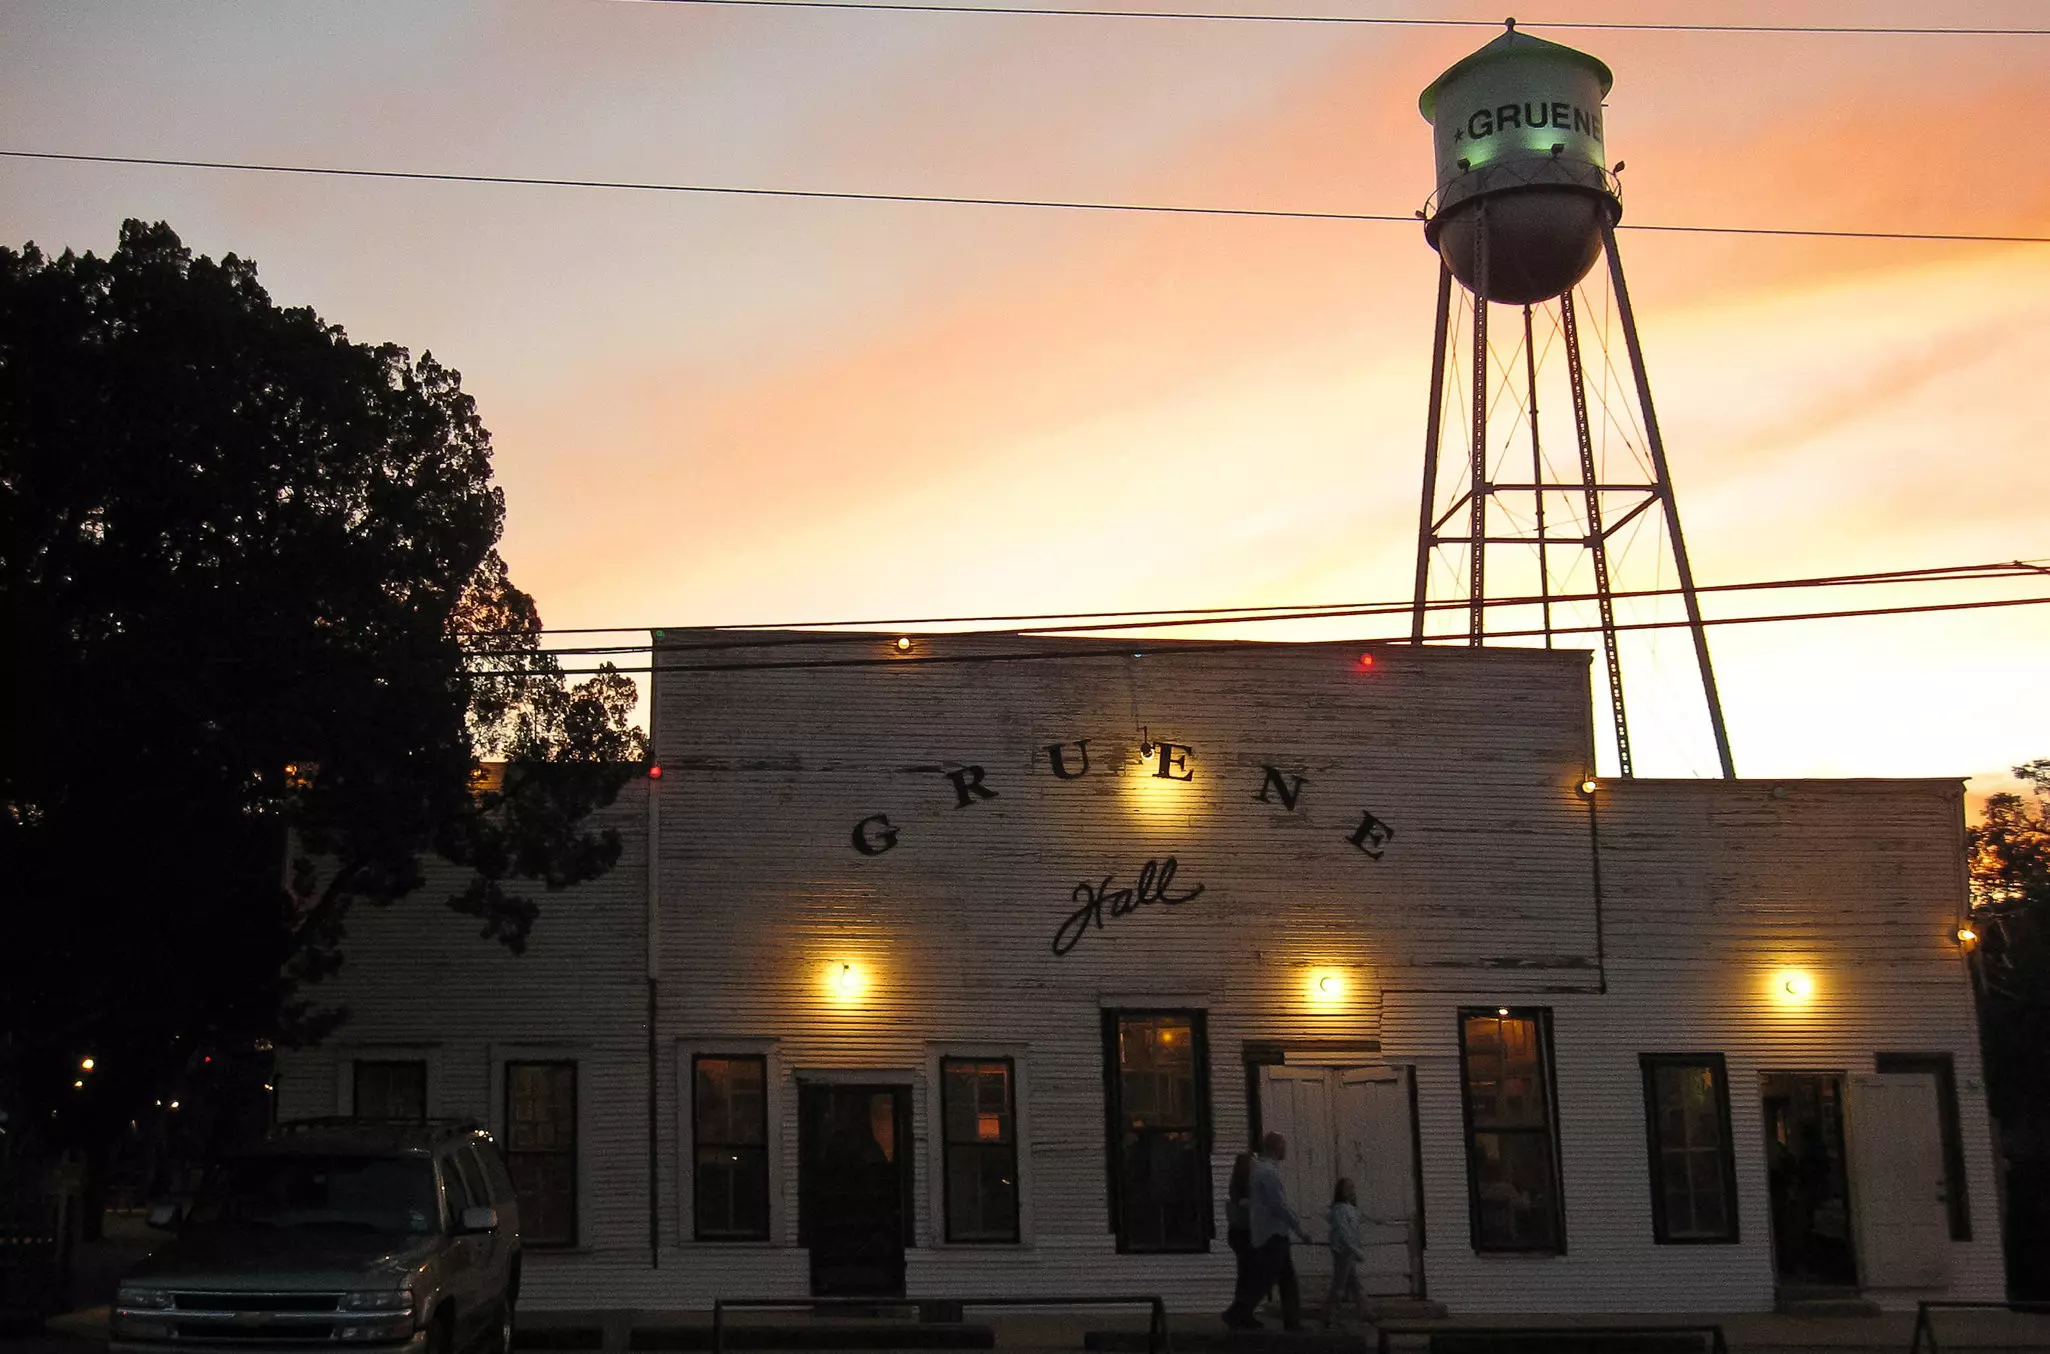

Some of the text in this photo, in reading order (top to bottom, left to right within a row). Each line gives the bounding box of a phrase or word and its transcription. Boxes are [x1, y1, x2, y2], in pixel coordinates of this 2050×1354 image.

[1467, 102, 1602, 142] GRUENE
[851, 739, 1394, 860] GRUENE
[1052, 856, 1205, 956] Hall
